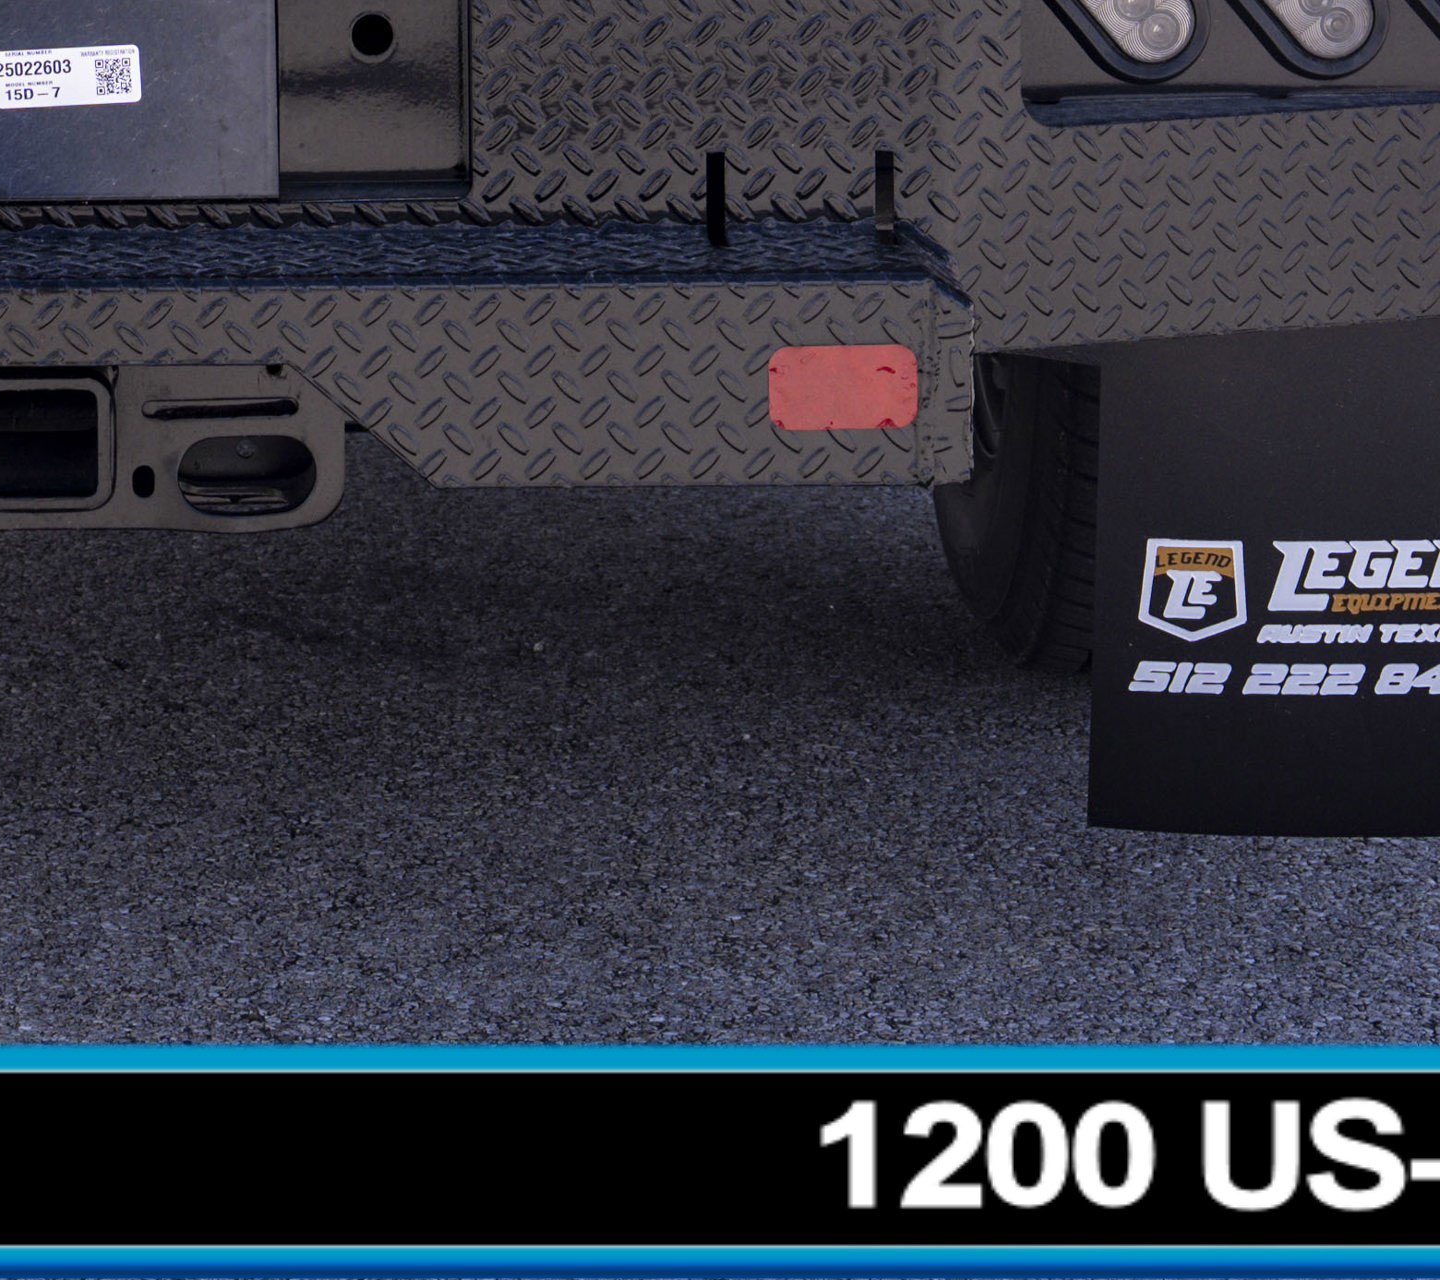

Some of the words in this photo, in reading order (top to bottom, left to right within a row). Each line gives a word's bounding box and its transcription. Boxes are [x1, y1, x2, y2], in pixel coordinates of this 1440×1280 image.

[5, 88, 34, 100] 15D
[52, 86, 61, 98] 7
[1154, 551, 1232, 569] LEGEND
[1256, 624, 1373, 644] AUSTIN
[1128, 660, 1232, 695] 512
[1242, 663, 1366, 695] 222
